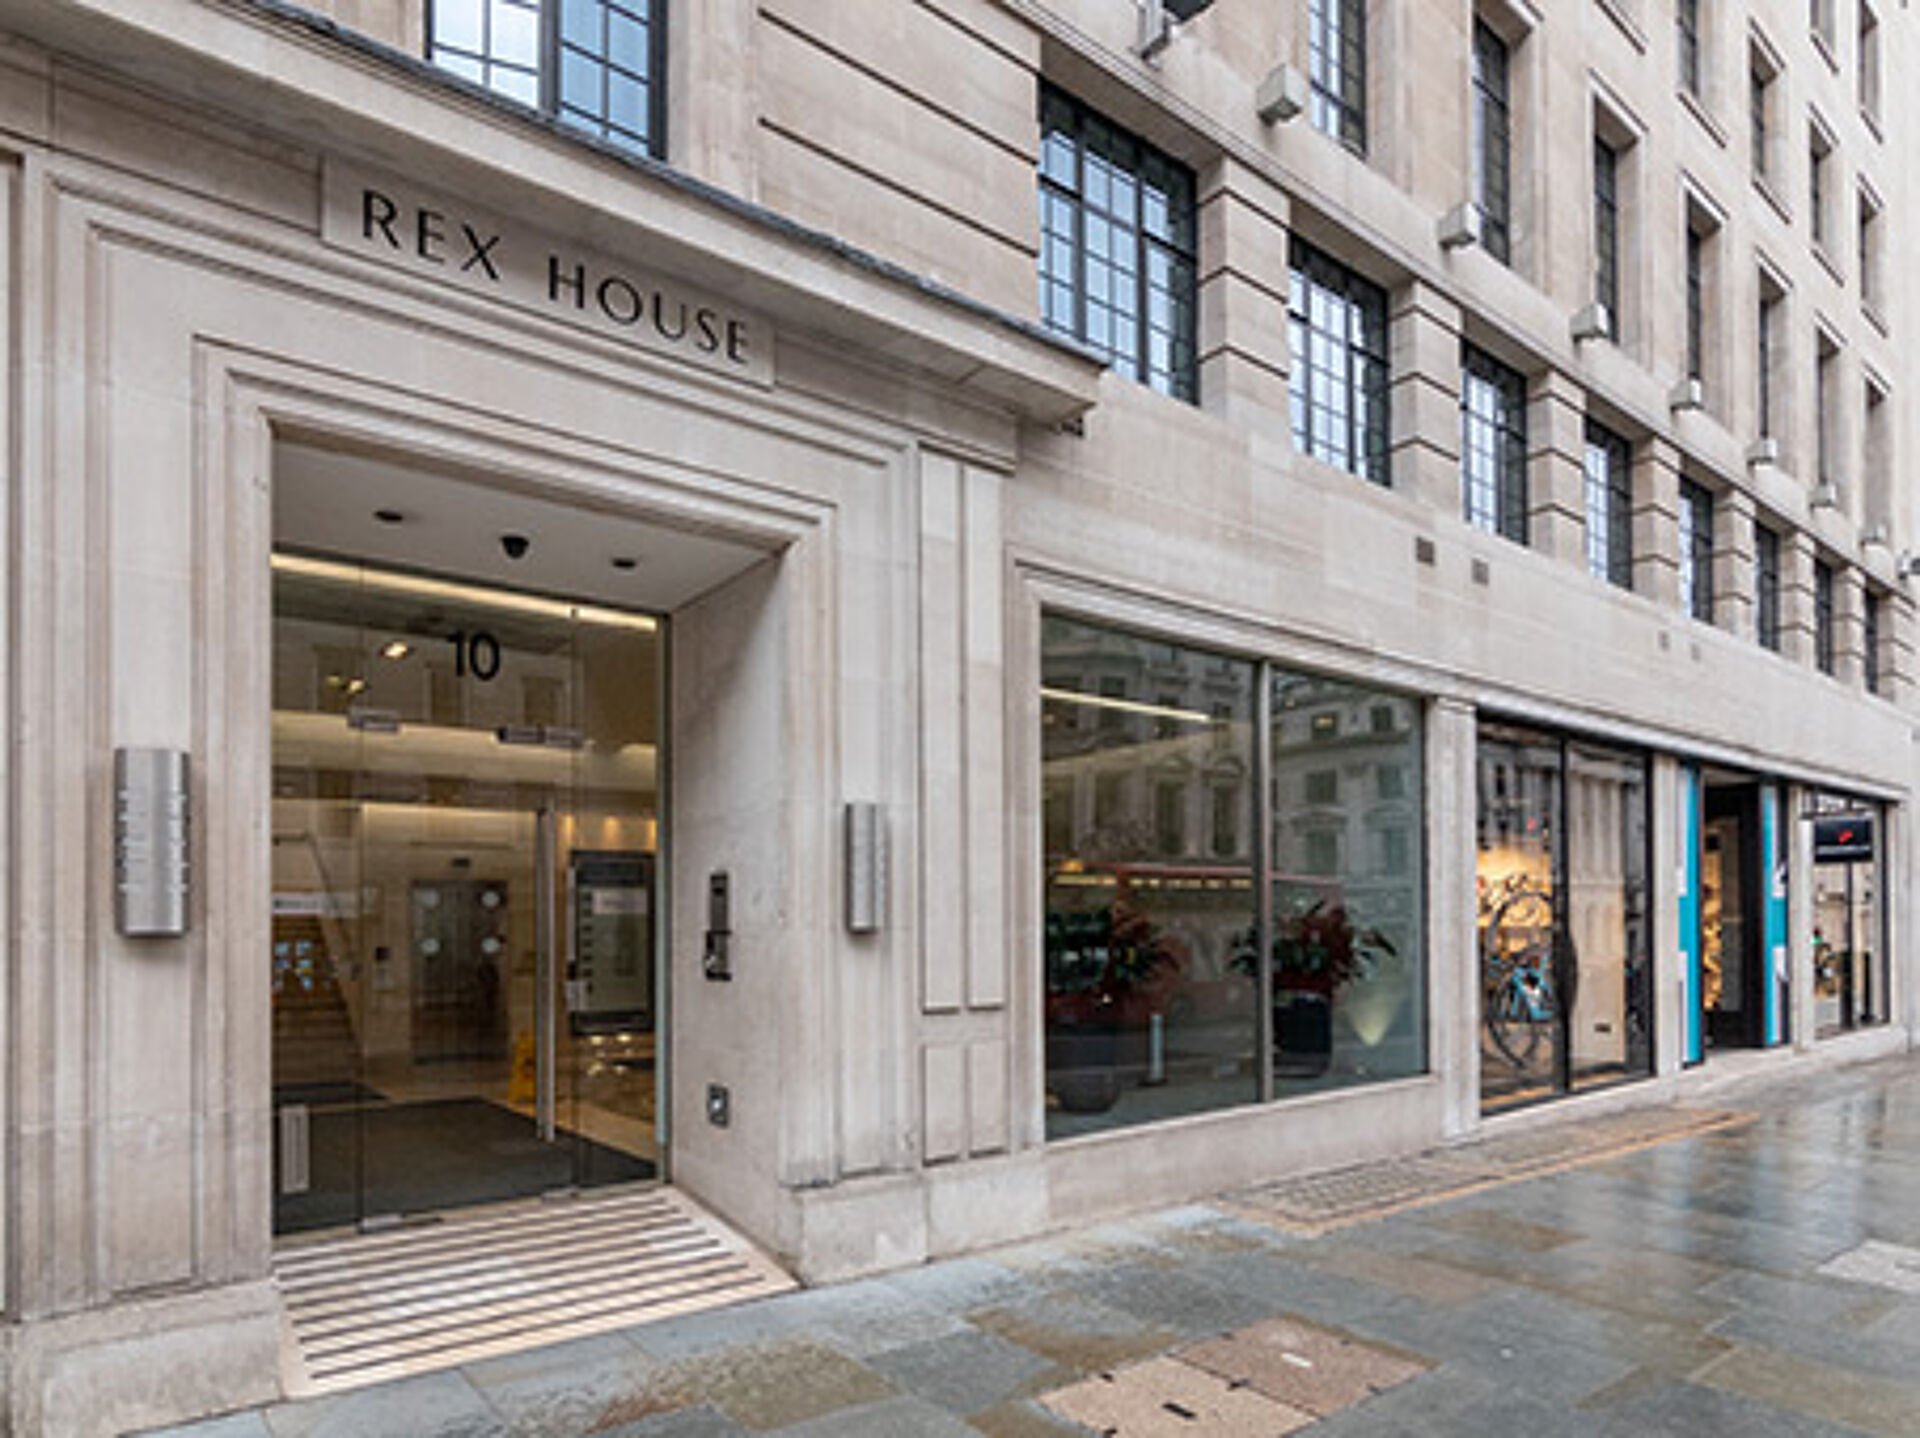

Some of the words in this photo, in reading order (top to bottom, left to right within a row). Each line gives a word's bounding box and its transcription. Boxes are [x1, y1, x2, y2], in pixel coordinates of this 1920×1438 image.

[361, 189, 500, 282] REX
[548, 255, 749, 364] HOUSE
[446, 630, 501, 681] 10
